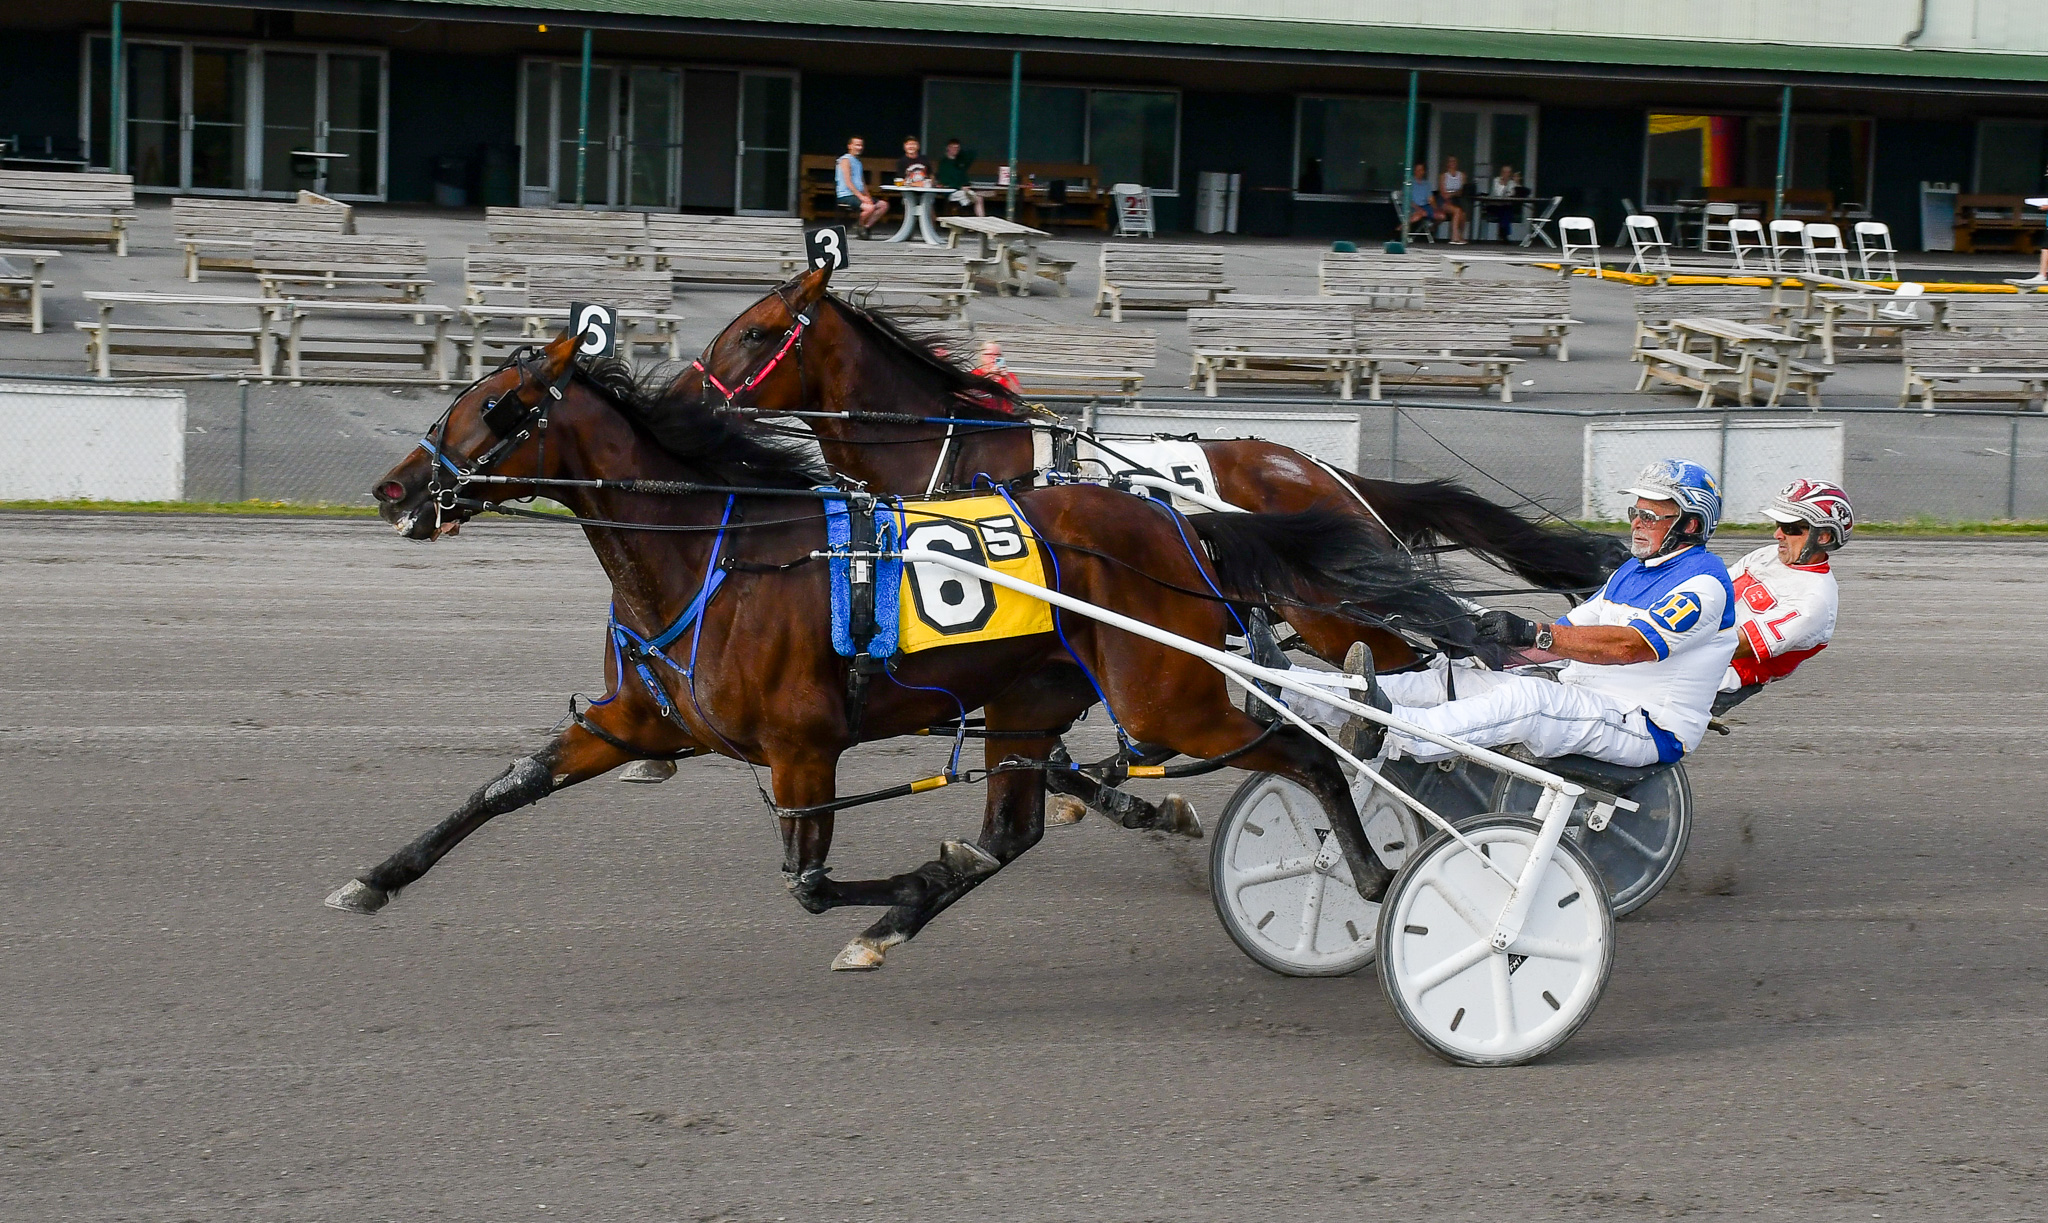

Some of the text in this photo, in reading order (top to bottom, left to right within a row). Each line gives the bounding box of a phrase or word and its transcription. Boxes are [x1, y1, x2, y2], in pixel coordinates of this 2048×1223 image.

[815, 229, 841, 270] 3
[577, 305, 610, 355] 6
[1170, 465, 1205, 500] 5
[977, 517, 1022, 557] 5
[905, 523, 989, 629] 6
[1652, 593, 1700, 631] H
[1764, 609, 1801, 642] L
